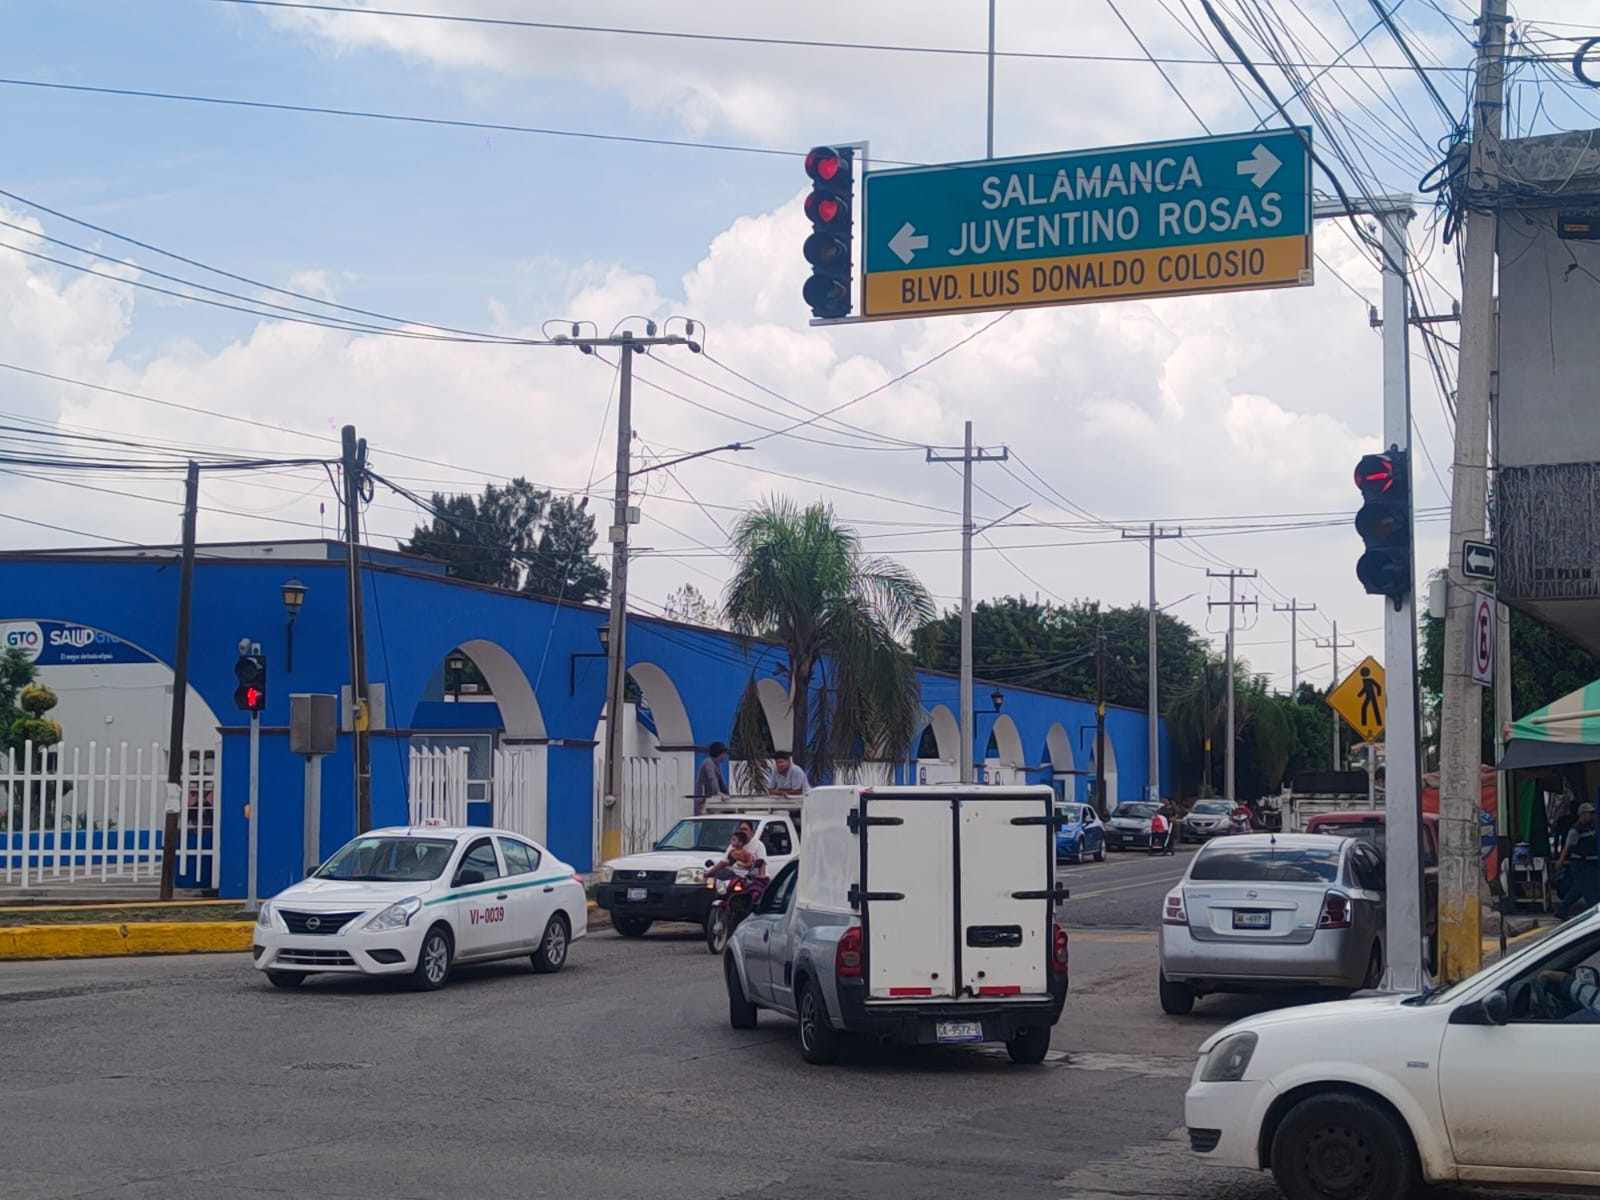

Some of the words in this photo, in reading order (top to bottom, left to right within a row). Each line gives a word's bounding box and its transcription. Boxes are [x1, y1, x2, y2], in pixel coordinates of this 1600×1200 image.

[981, 155, 1203, 210] SALAMANCA
[948, 205, 1140, 257] JUVENTINO
[1158, 192, 1283, 237] ROSAS
[901, 275, 962, 304] BLVD.
[969, 269, 1020, 299] LUIS
[1032, 258, 1145, 294] DONALDO
[1158, 247, 1265, 282] COLOSIO
[7, 631, 38, 646] GTO
[470, 906, 505, 926] VI-0039
